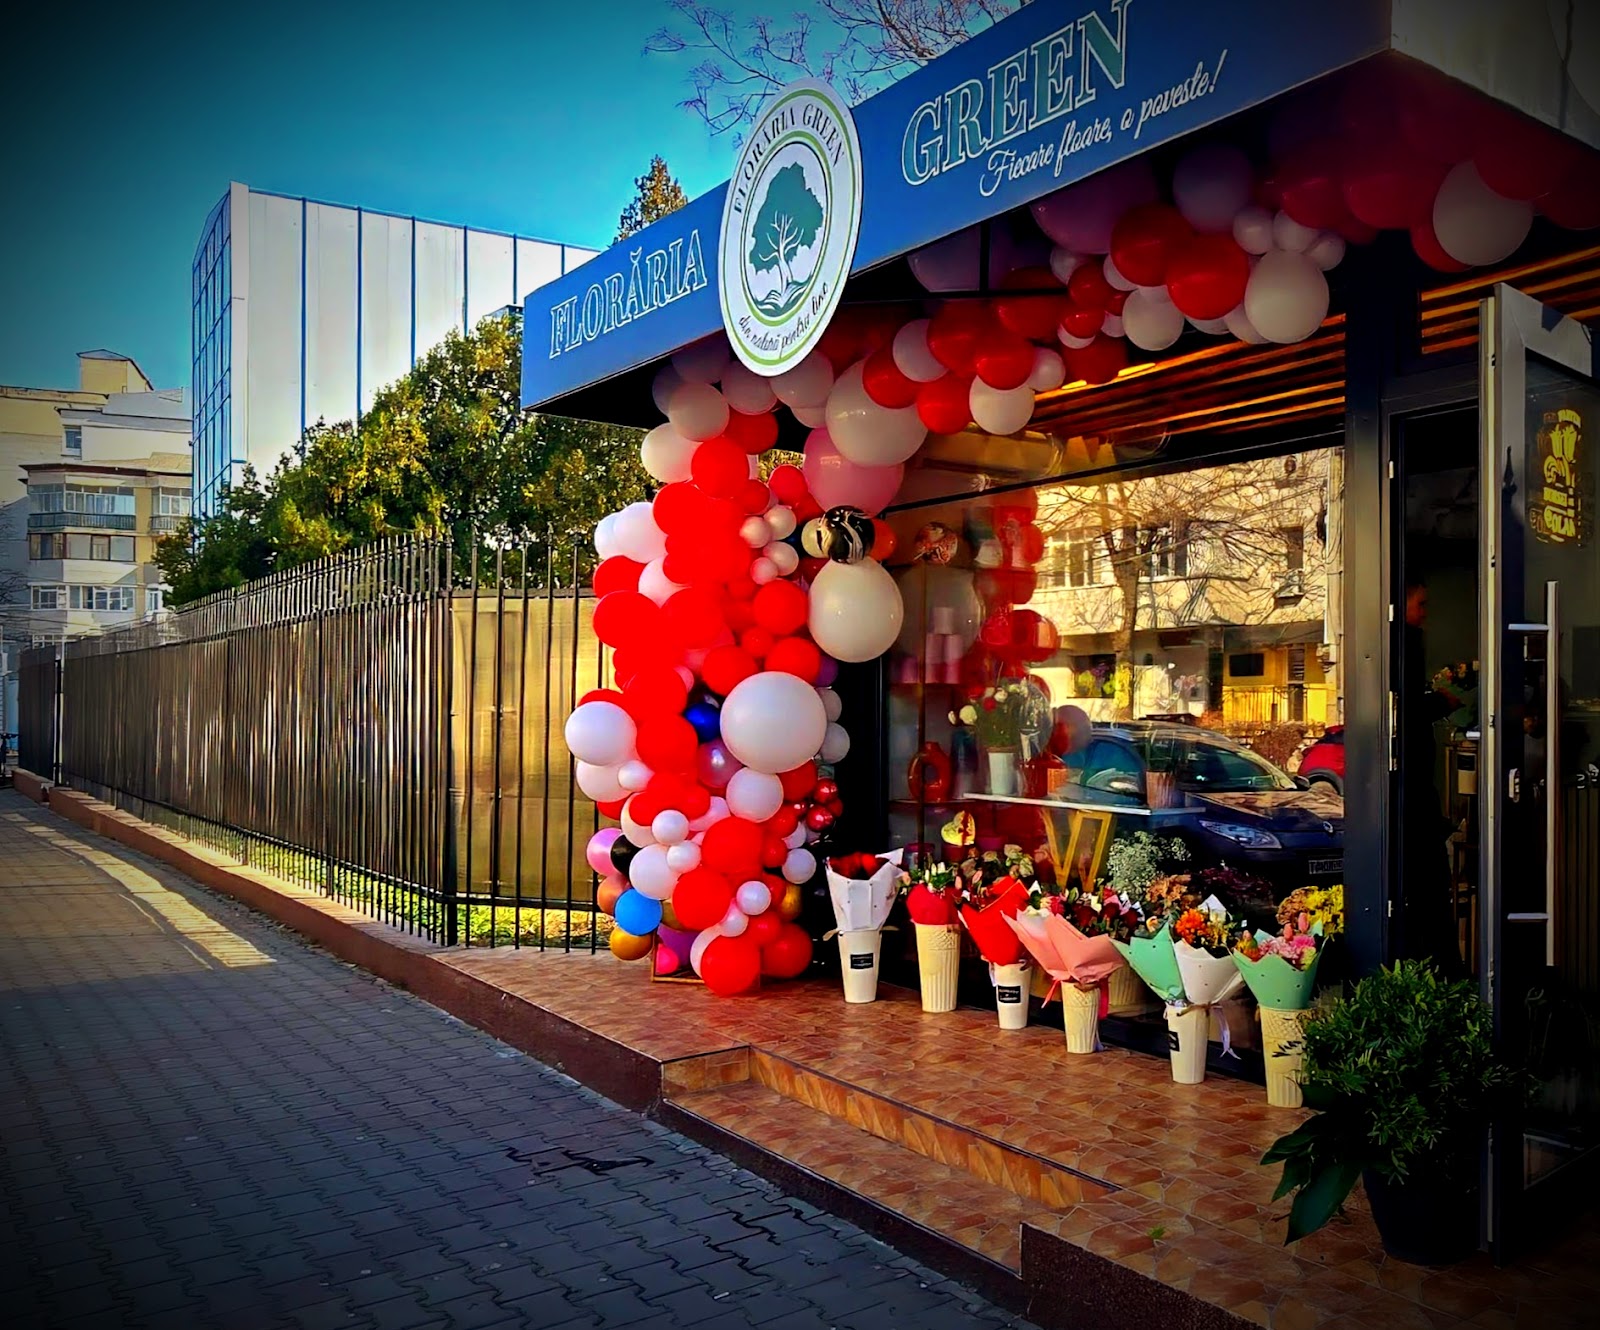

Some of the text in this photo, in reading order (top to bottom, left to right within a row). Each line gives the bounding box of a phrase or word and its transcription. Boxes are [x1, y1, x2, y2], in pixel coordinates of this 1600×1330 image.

[802, 103, 845, 168] GREEN
[901, 0, 1133, 186] GREEN
[979, 143, 1055, 197] Fiecare
[1053, 119, 1113, 178] floare,
[1133, 49, 1228, 140] poveste!
[548, 228, 708, 360] FLORĂRIA
